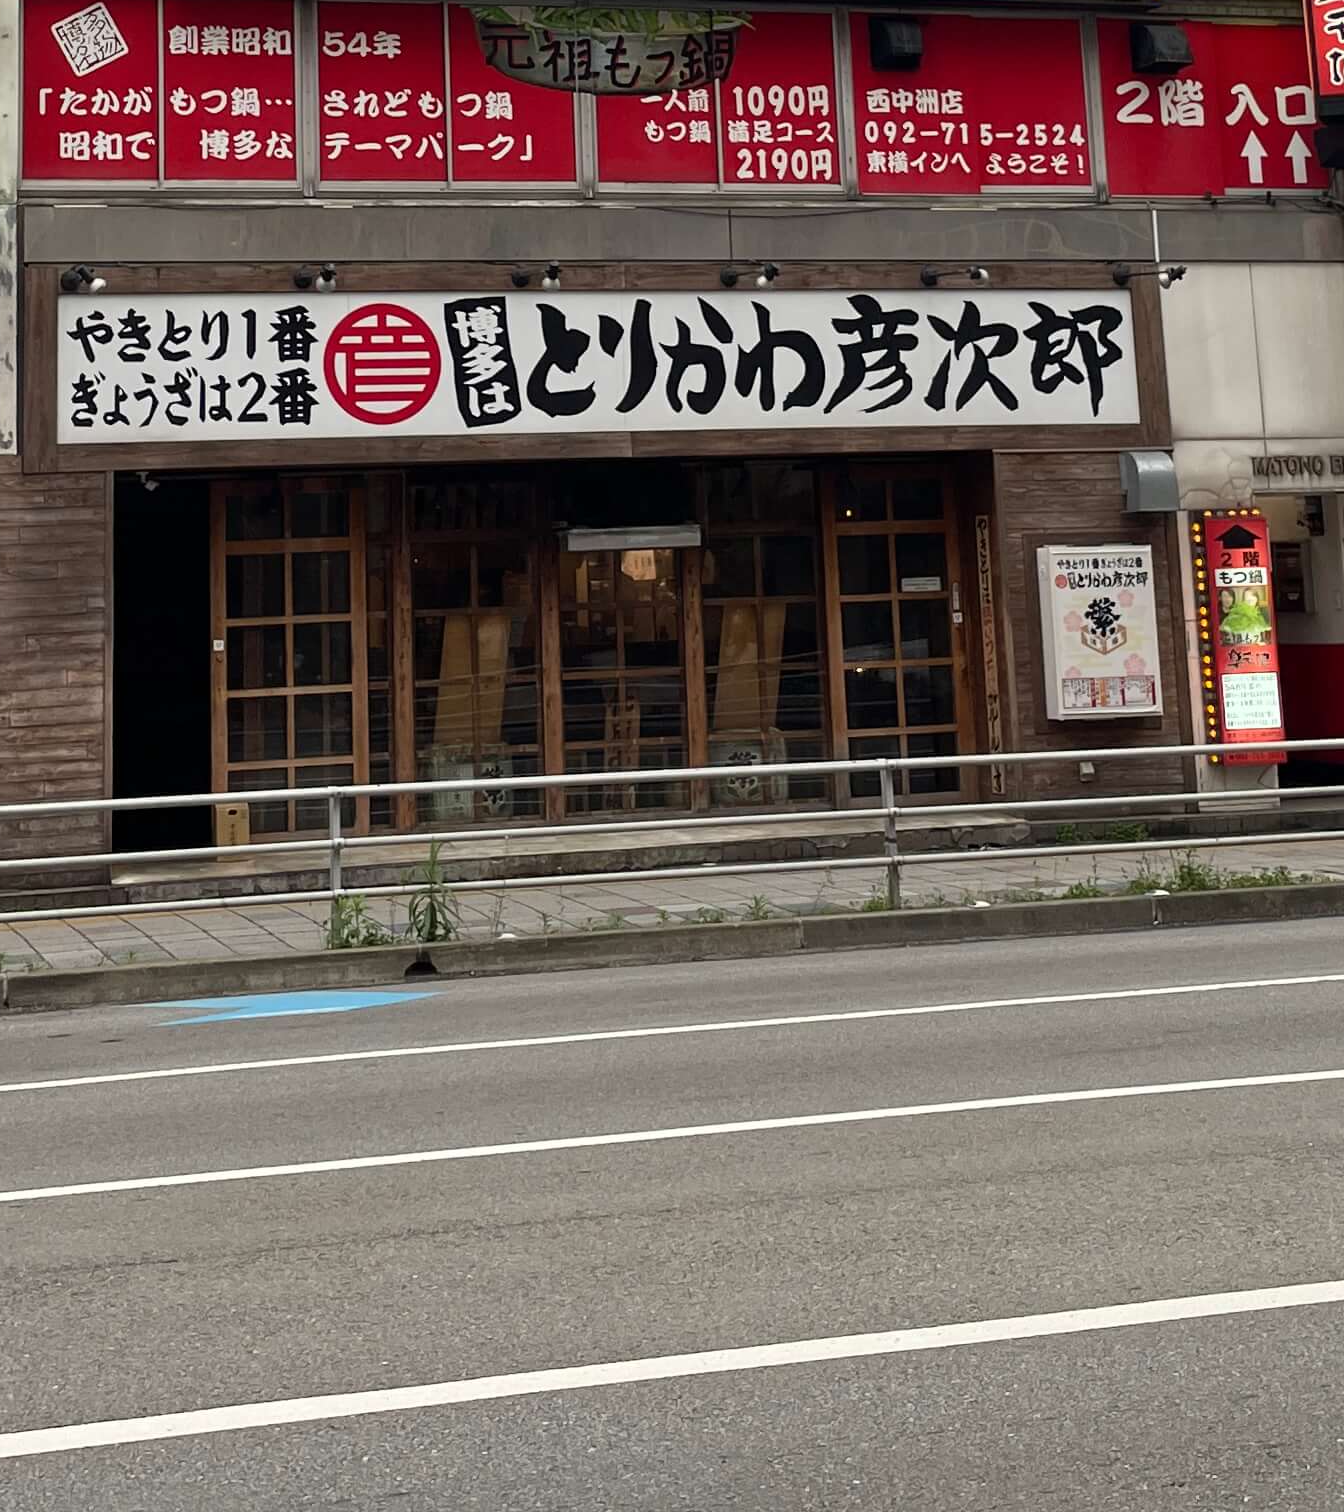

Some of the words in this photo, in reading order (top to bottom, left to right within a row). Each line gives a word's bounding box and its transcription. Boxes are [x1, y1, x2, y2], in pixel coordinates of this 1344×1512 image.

[167, 25, 293, 59] 創業昭和
[322, 30, 402, 59] 54年
[481, 22, 734, 90] 元祖もつ鍋
[640, 88, 711, 114] 一人前
[731, 85, 830, 118] 1090円
[865, 88, 964, 116] 西中洲店
[1115, 80, 1206, 128] 2階
[1225, 82, 1316, 128] 入口
[59, 130, 156, 163] 昭和で
[199, 130, 294, 162] 博多な
[643, 119, 712, 146] もつ鍋
[726, 120, 835, 146] 満足コース
[736, 149, 834, 183] 2190円
[866, 148, 972, 176] 東横インへ
[984, 151, 1087, 176] ようこそ!
[66, 305, 319, 363] やきとり1番
[450, 305, 515, 418] 博多は
[527, 295, 1123, 417] とりかわ彦次郎
[69, 366, 320, 427] ぎょうざは2番
[1220, 551, 1261, 568] 2階
[1218, 569, 1264, 585] もつ鍋
